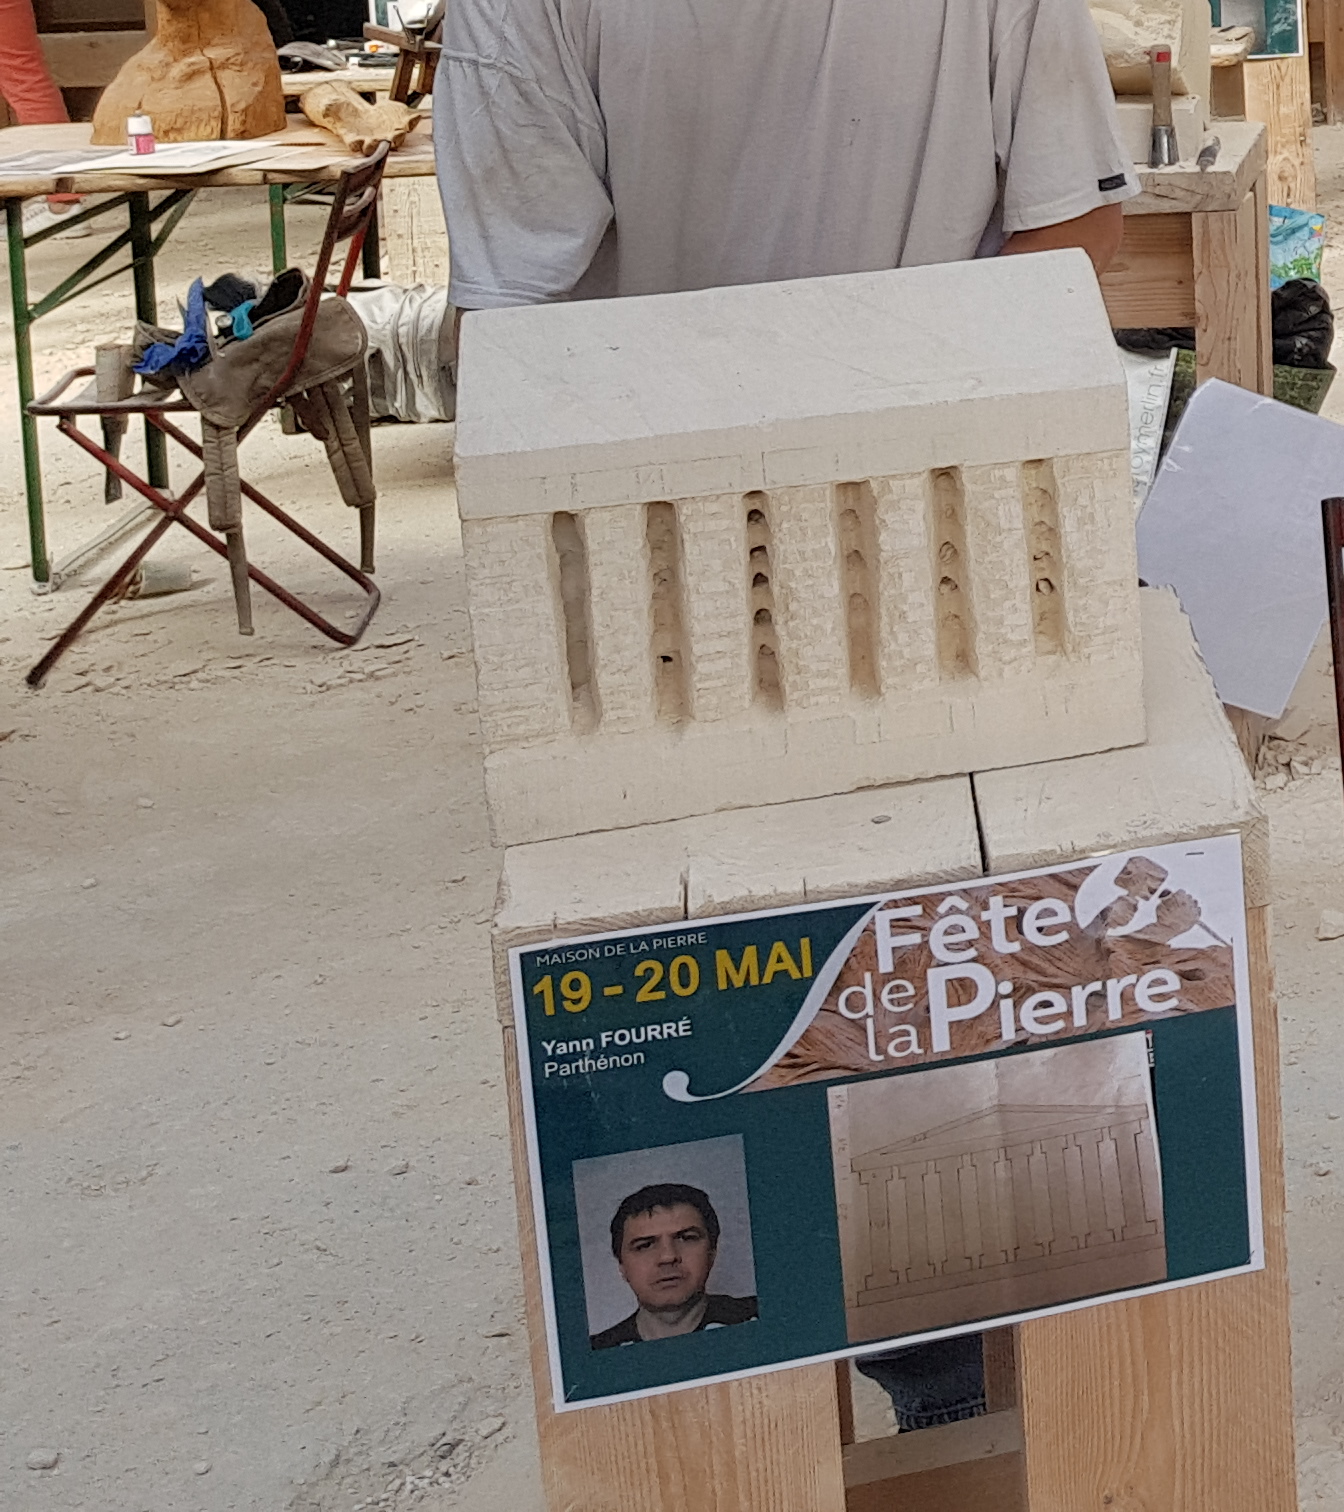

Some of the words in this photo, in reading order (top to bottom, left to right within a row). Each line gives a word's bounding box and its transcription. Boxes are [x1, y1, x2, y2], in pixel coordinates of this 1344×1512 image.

[535, 948, 601, 967] MAISON
[604, 943, 626, 958] DE
[629, 939, 649, 954] LA
[652, 932, 708, 950] PIERRE
[874, 894, 1072, 974] Fête
[532, 970, 593, 1017] 19
[634, 954, 701, 1003] 20
[714, 937, 814, 991] MAI
[837, 971, 916, 1020] de
[926, 962, 1182, 1053] Pierre
[541, 1037, 594, 1057] Yann
[600, 1016, 693, 1048] FOURRÉ
[866, 1015, 923, 1062] la
[544, 1052, 645, 1078] Parthénon
